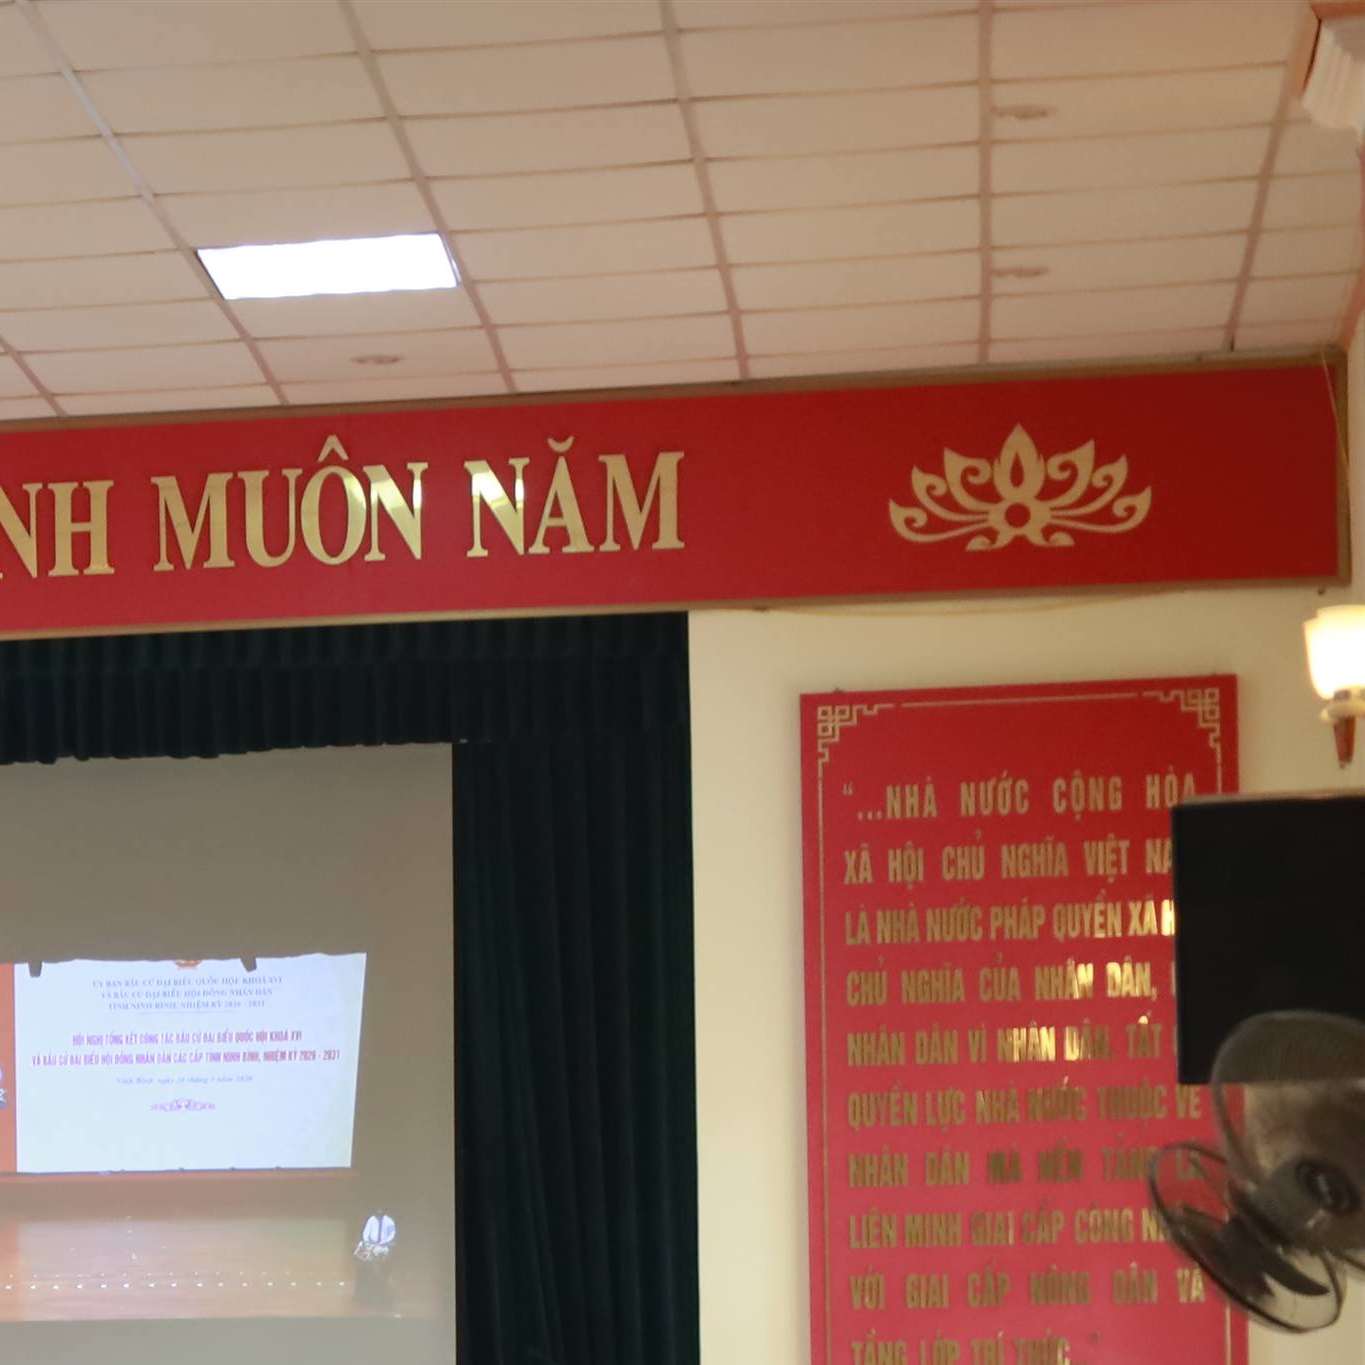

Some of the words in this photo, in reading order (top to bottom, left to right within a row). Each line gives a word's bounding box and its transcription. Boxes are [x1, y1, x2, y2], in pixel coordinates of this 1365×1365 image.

[151, 434, 428, 572] MUÔN
[463, 435, 686, 558] NĂM
[961, 769, 1030, 817] NƯỚC
[1053, 769, 1123, 822] CỘNG
[844, 842, 873, 884] XÃ
[888, 840, 925, 891] HỘI
[942, 828, 985, 880] CHỦ
[1001, 835, 1069, 879] NGHĨA
[1083, 832, 1130, 884] VIỆT
[1145, 837, 1173, 875] NA
[845, 902, 869, 945] LÀ
[877, 901, 919, 943] NHÀ
[926, 896, 983, 941] NƯỚC
[990, 896, 1045, 939] PHÁP
[1053, 889, 1122, 942] QUYỀN
[1128, 893, 1158, 937] XÃ
[846, 954, 888, 1006] CHỦ
[901, 961, 966, 1004] NGHĨA
[979, 951, 1021, 1000] CỦA
[1034, 956, 1093, 1000] NHÂN
[1107, 954, 1158, 1001] DÂN,
[847, 1024, 906, 1066] NHÂN
[915, 1022, 959, 1065] DÂN
[997, 1020, 1057, 1063] NHÂN
[1125, 1009, 1162, 1059] TẤT
[848, 1207, 899, 1249] LIÊN
[903, 1210, 962, 1247] MINH
[970, 1208, 1015, 1246] GIAI
[1021, 1196, 1065, 1245] CẤP
[1074, 1202, 1135, 1243] CÔNG
[849, 1264, 886, 1311] VỚI
[905, 1272, 950, 1309] GIAI
[966, 1261, 1011, 1308] CẤP
[1112, 1260, 1159, 1305] DÂN
[1175, 1265, 1206, 1304] VÀ
